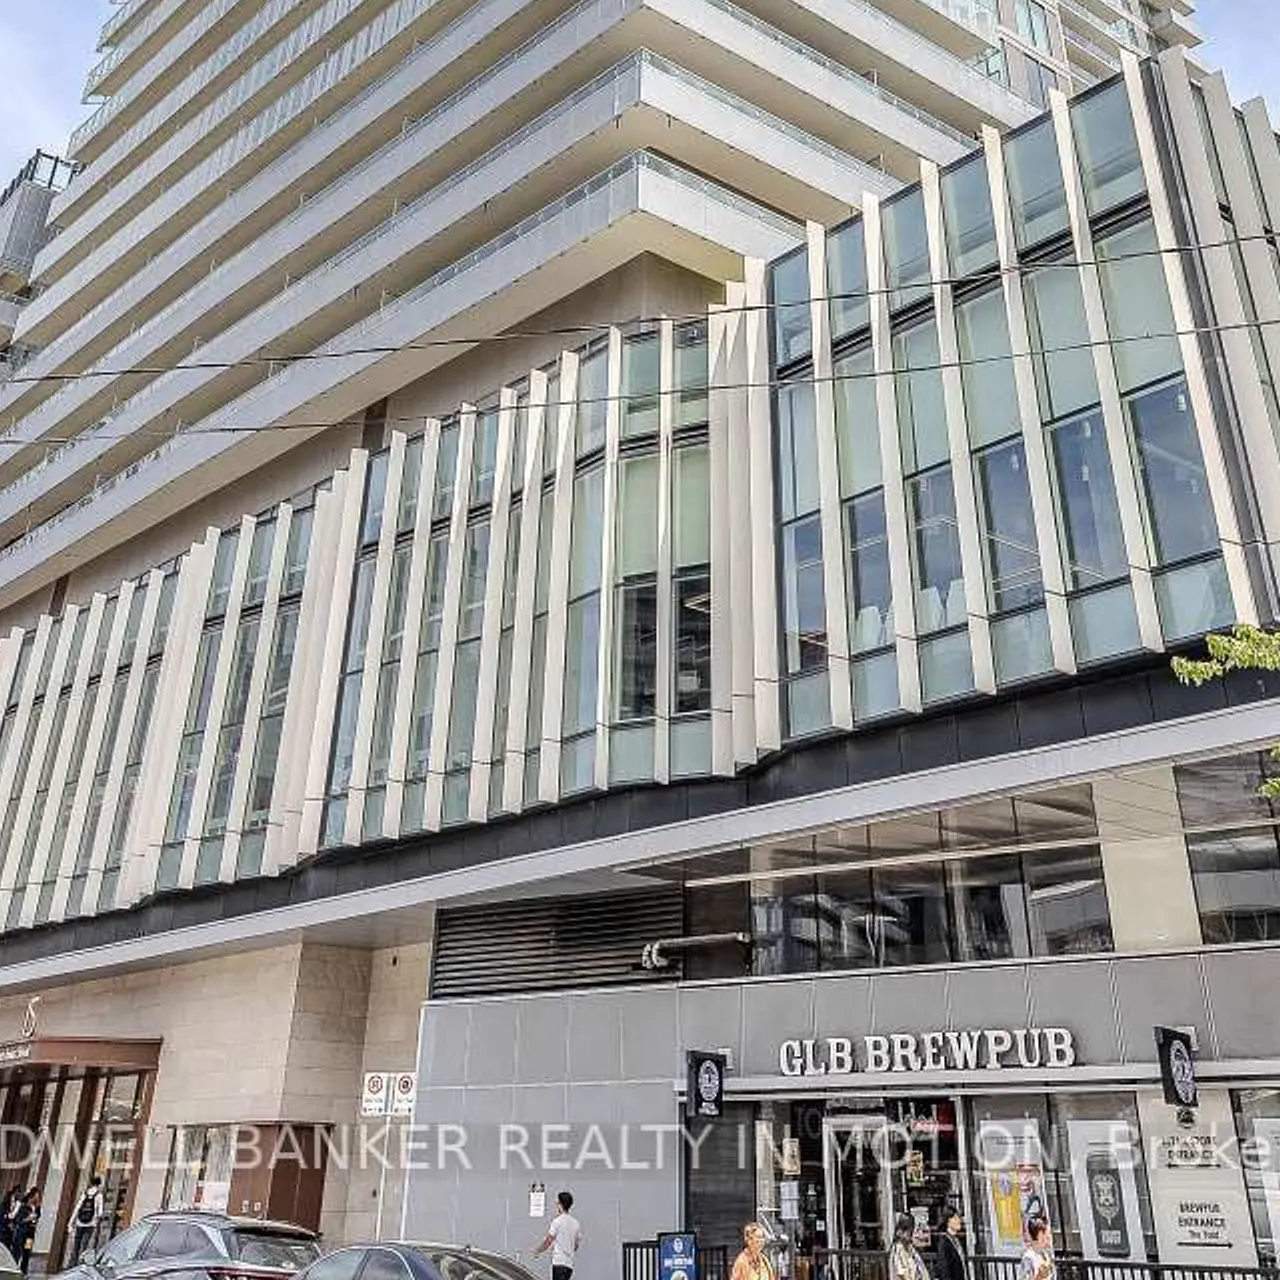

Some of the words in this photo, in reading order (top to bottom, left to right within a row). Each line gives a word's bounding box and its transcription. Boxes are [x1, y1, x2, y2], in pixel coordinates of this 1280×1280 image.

[780, 1038, 853, 1076] GLB
[864, 1027, 1076, 1072] BREWPUB
[1178, 1217, 1225, 1227] ENTRANCE
